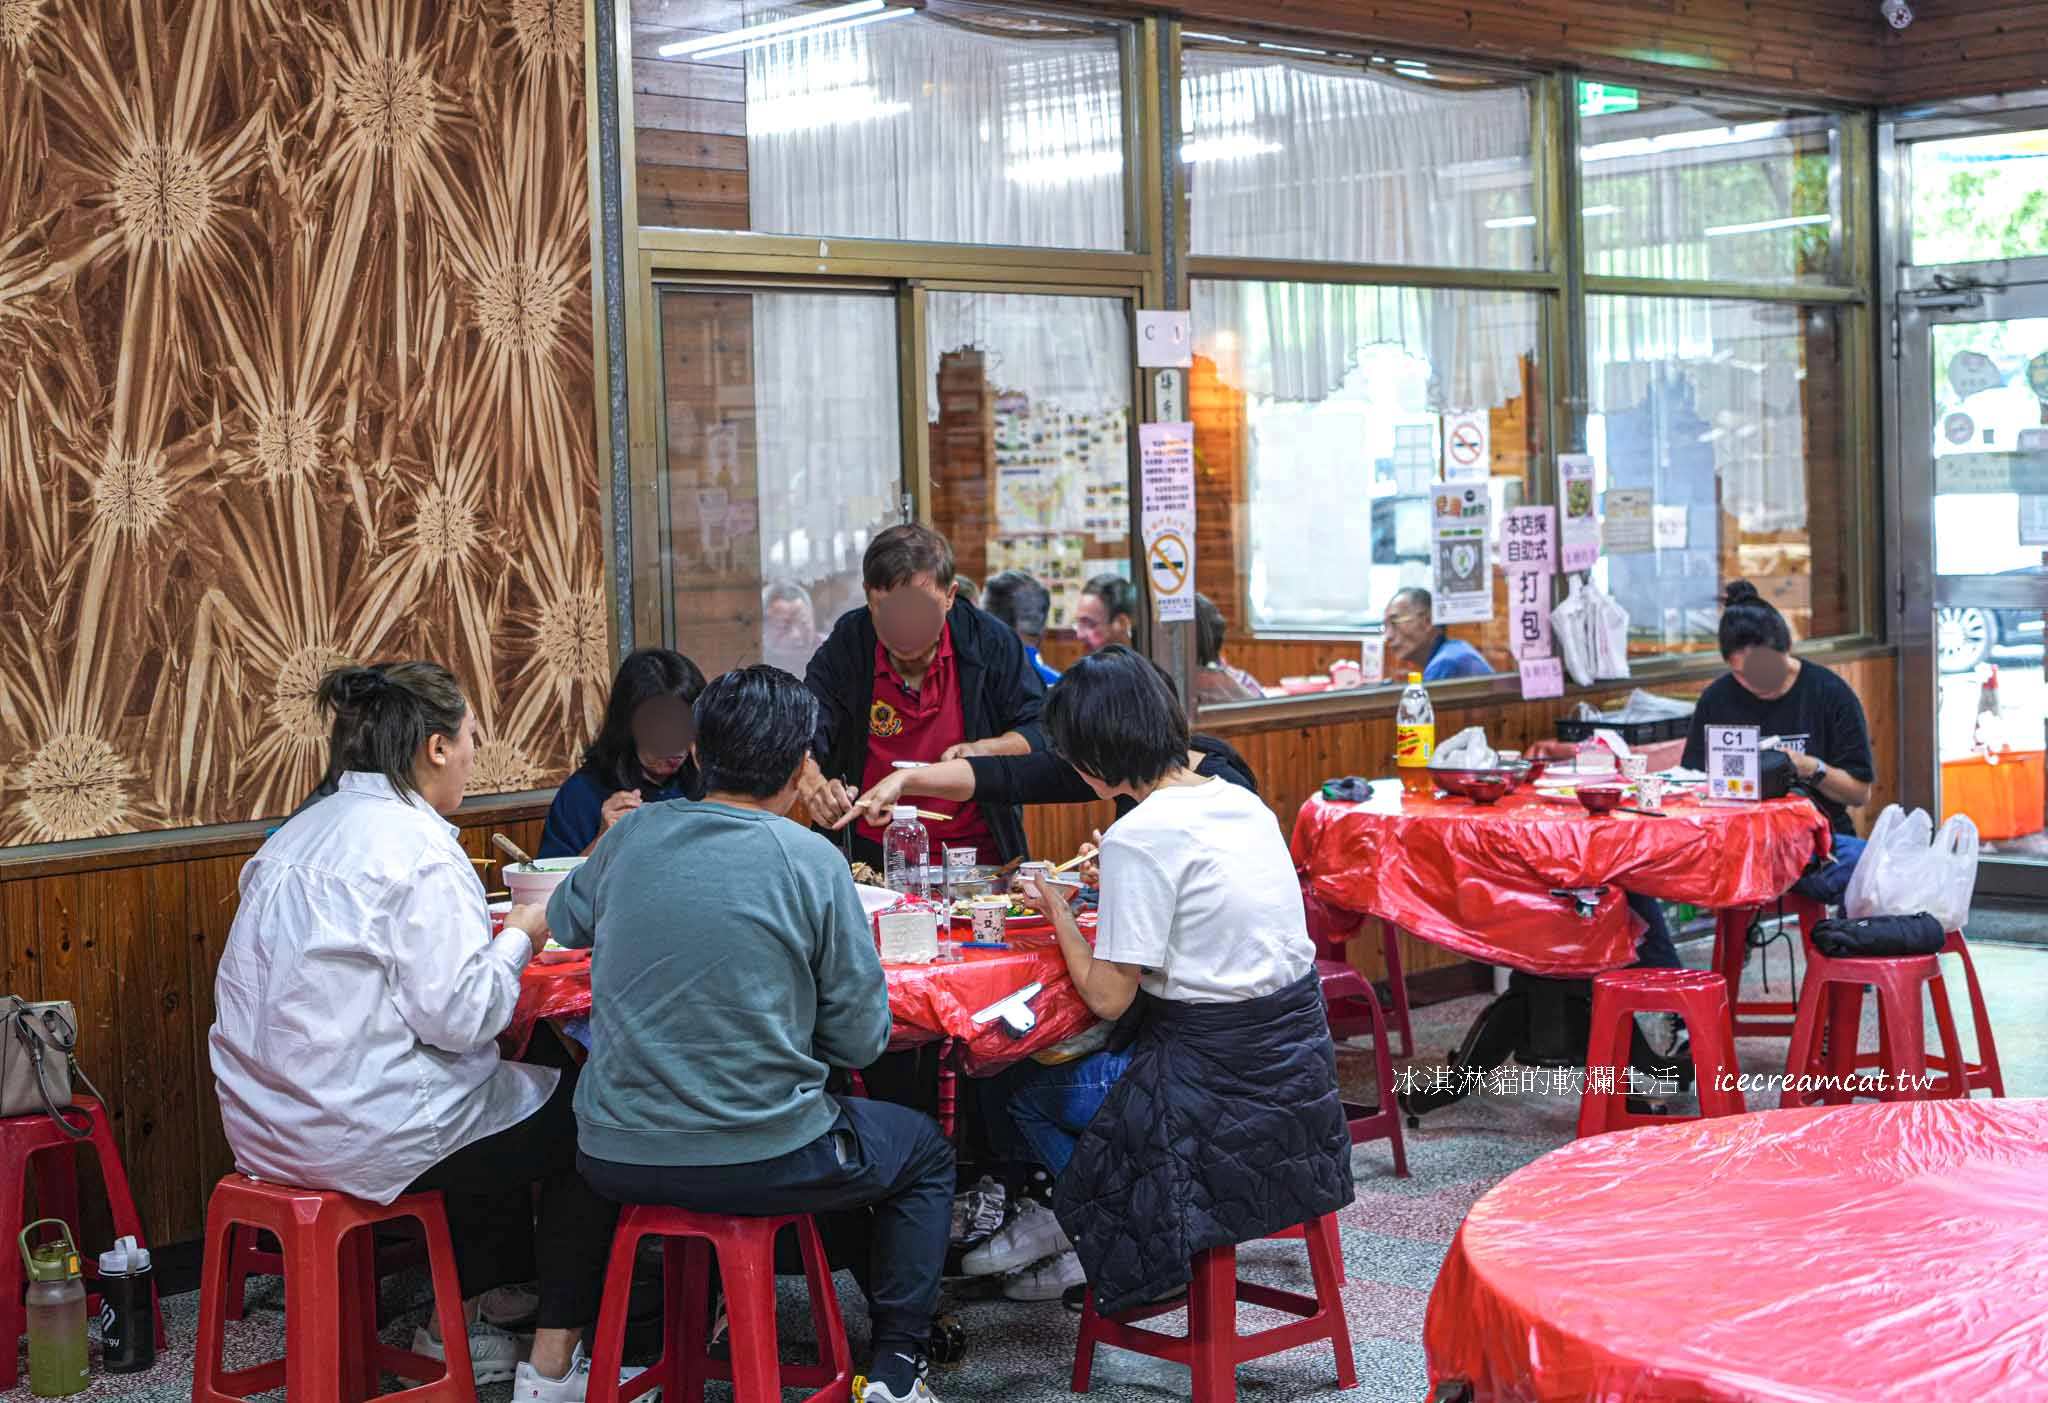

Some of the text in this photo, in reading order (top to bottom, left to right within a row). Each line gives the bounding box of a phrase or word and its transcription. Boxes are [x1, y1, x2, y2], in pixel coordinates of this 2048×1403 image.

[1145, 324, 1155, 341] C
[1508, 514, 1547, 536] 本店採
[1508, 539, 1548, 562] 自助式
[1520, 571, 1541, 641] 打包
[1722, 731, 1743, 745] C1
